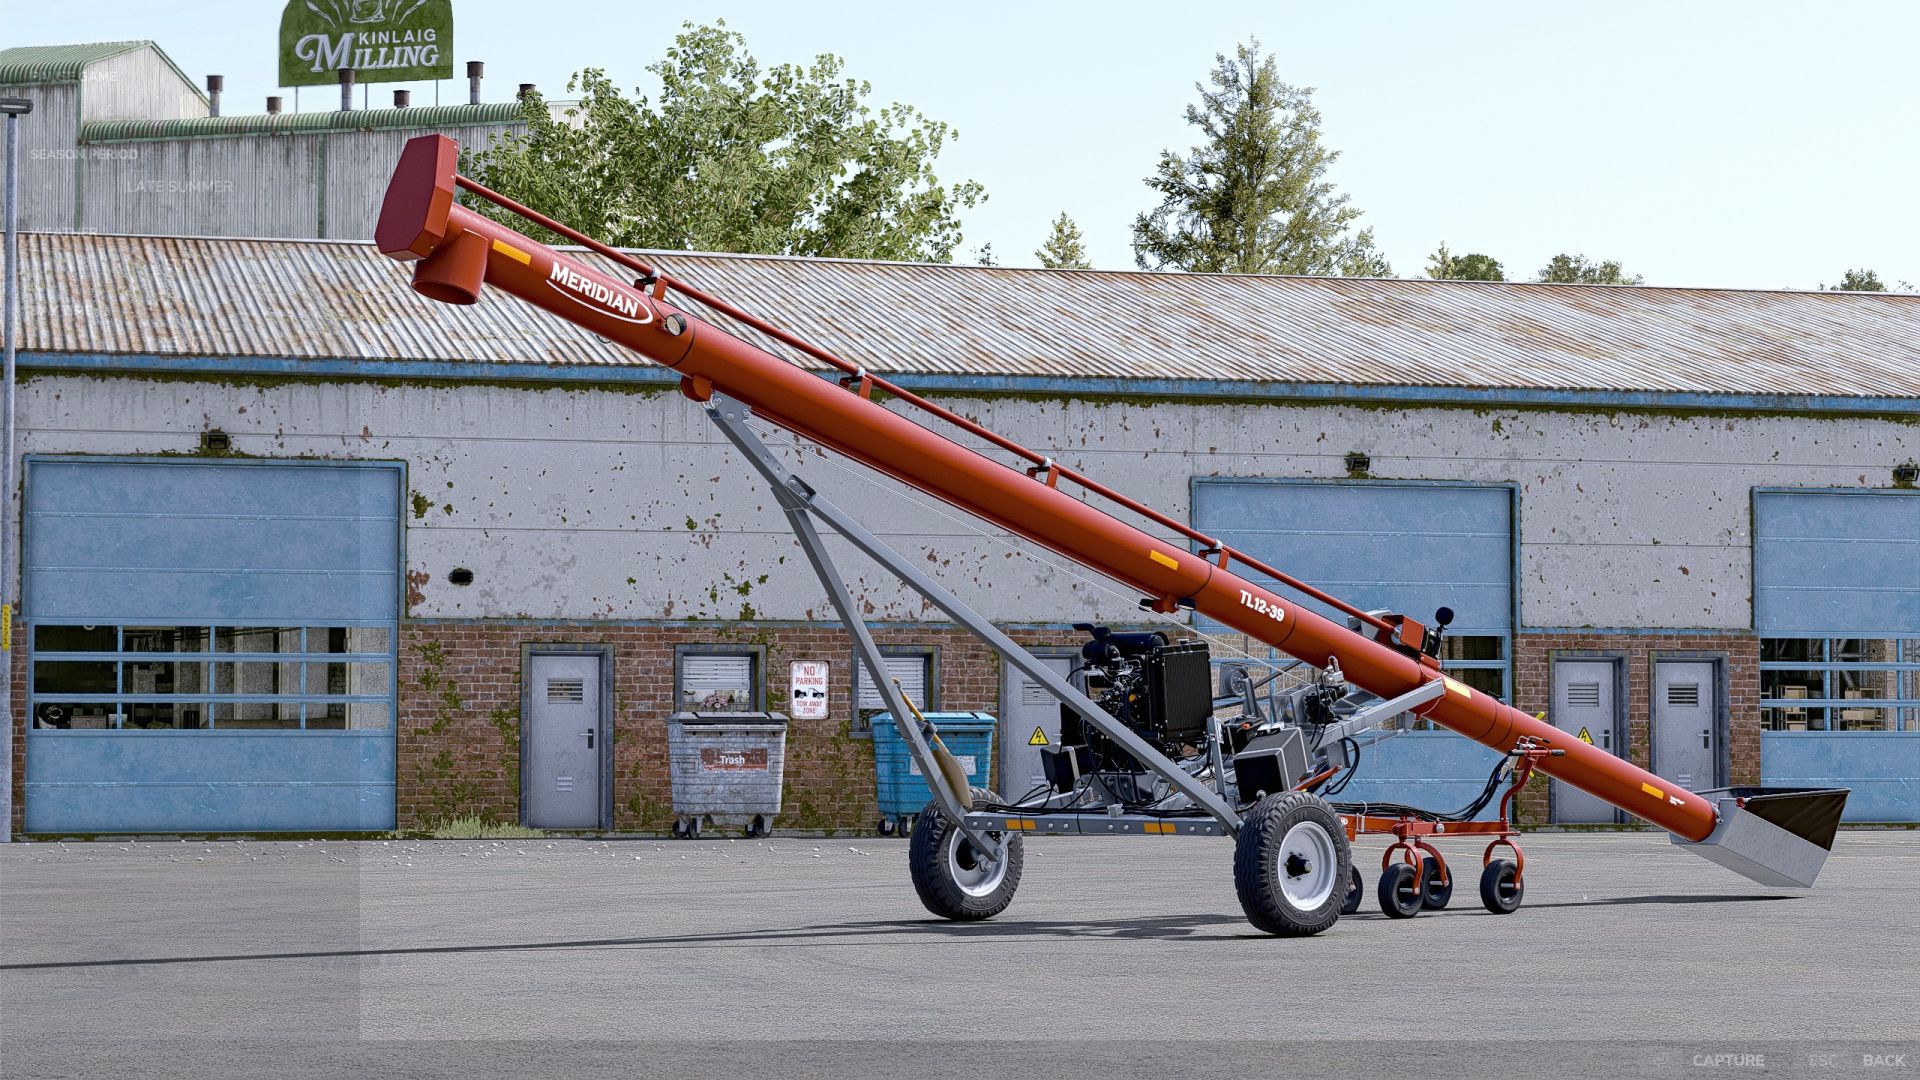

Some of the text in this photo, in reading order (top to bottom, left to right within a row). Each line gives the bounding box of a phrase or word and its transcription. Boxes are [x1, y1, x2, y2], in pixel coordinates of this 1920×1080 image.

[358, 28, 437, 45] KINLAIG
[295, 32, 440, 73] MILLING
[550, 261, 639, 318] MERIDIAN
[1240, 589, 1285, 622] TL12-39
[803, 665, 816, 676] NO
[795, 677, 823, 685] PARKING
[719, 754, 746, 766] Trash
